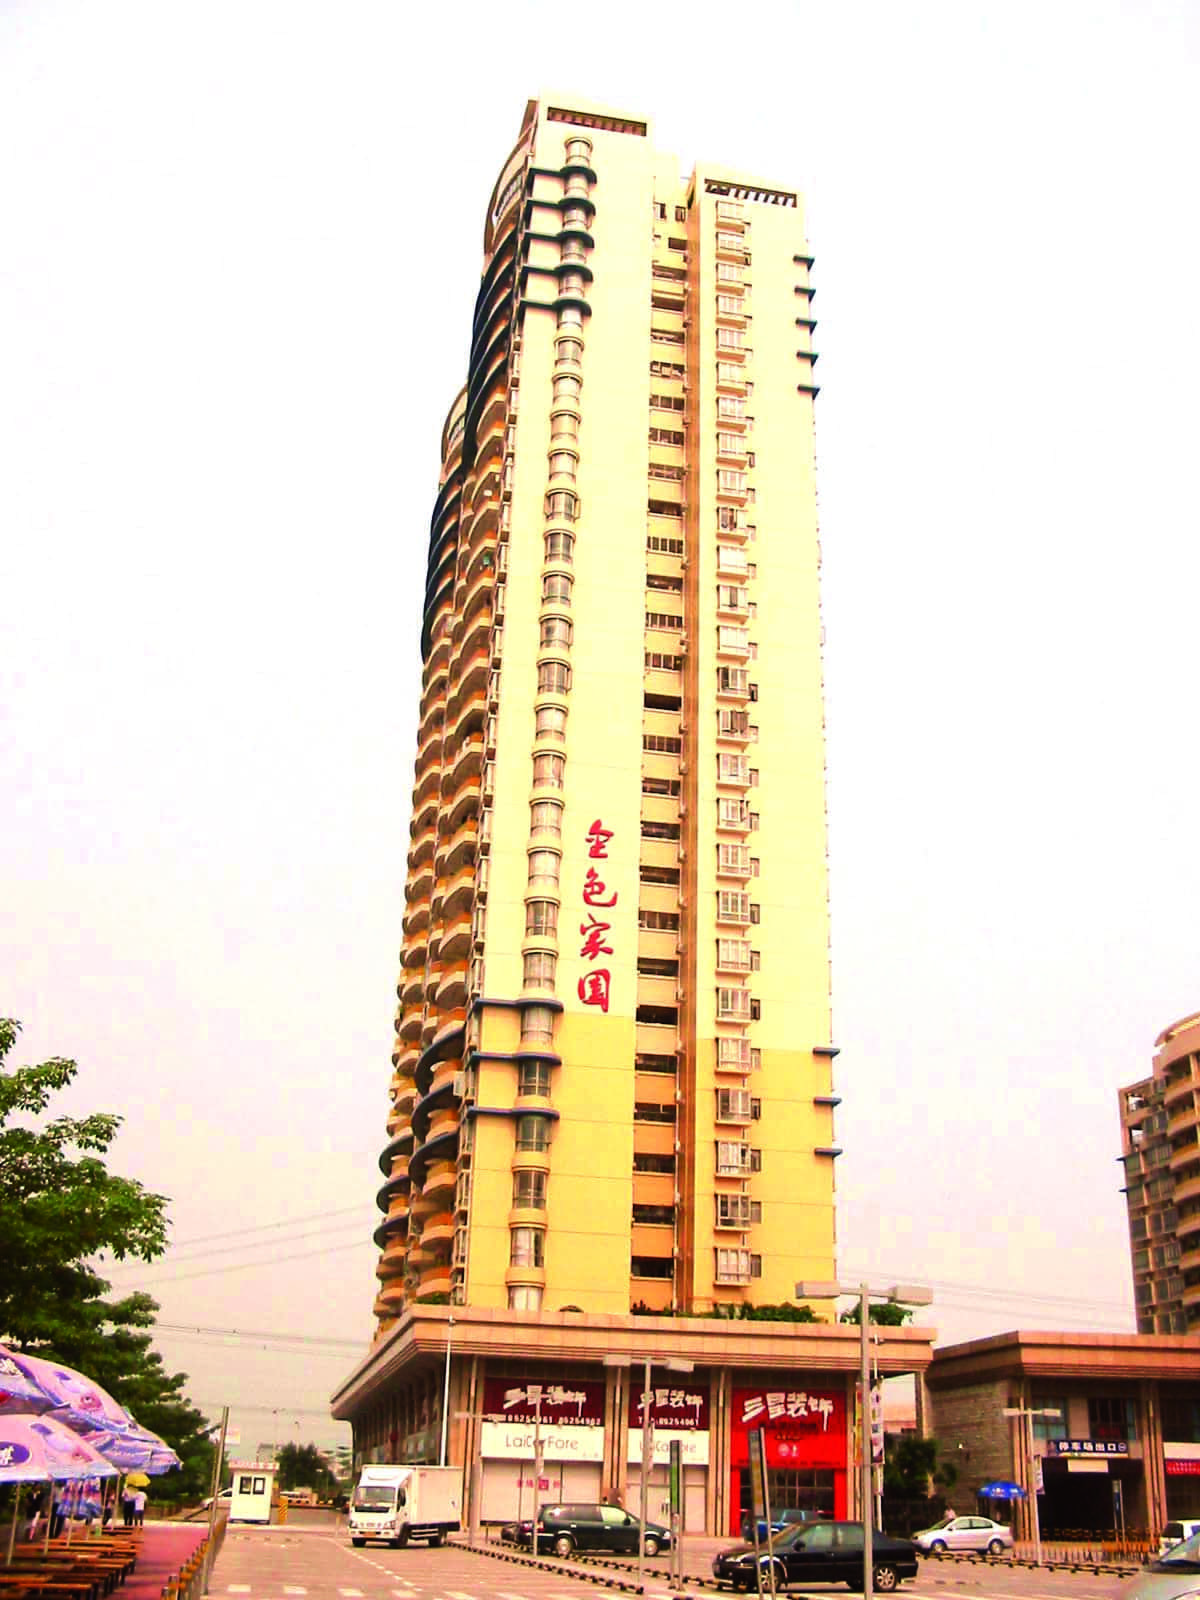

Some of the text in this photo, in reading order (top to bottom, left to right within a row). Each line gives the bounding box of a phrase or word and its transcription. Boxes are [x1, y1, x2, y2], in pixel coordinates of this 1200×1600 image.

[578, 819, 618, 1013] 金色家园
[637, 1389, 703, 1420] 三星装饰
[742, 1392, 833, 1432] 三星装饰
[1059, 1441, 1117, 1451] 停车场出口
